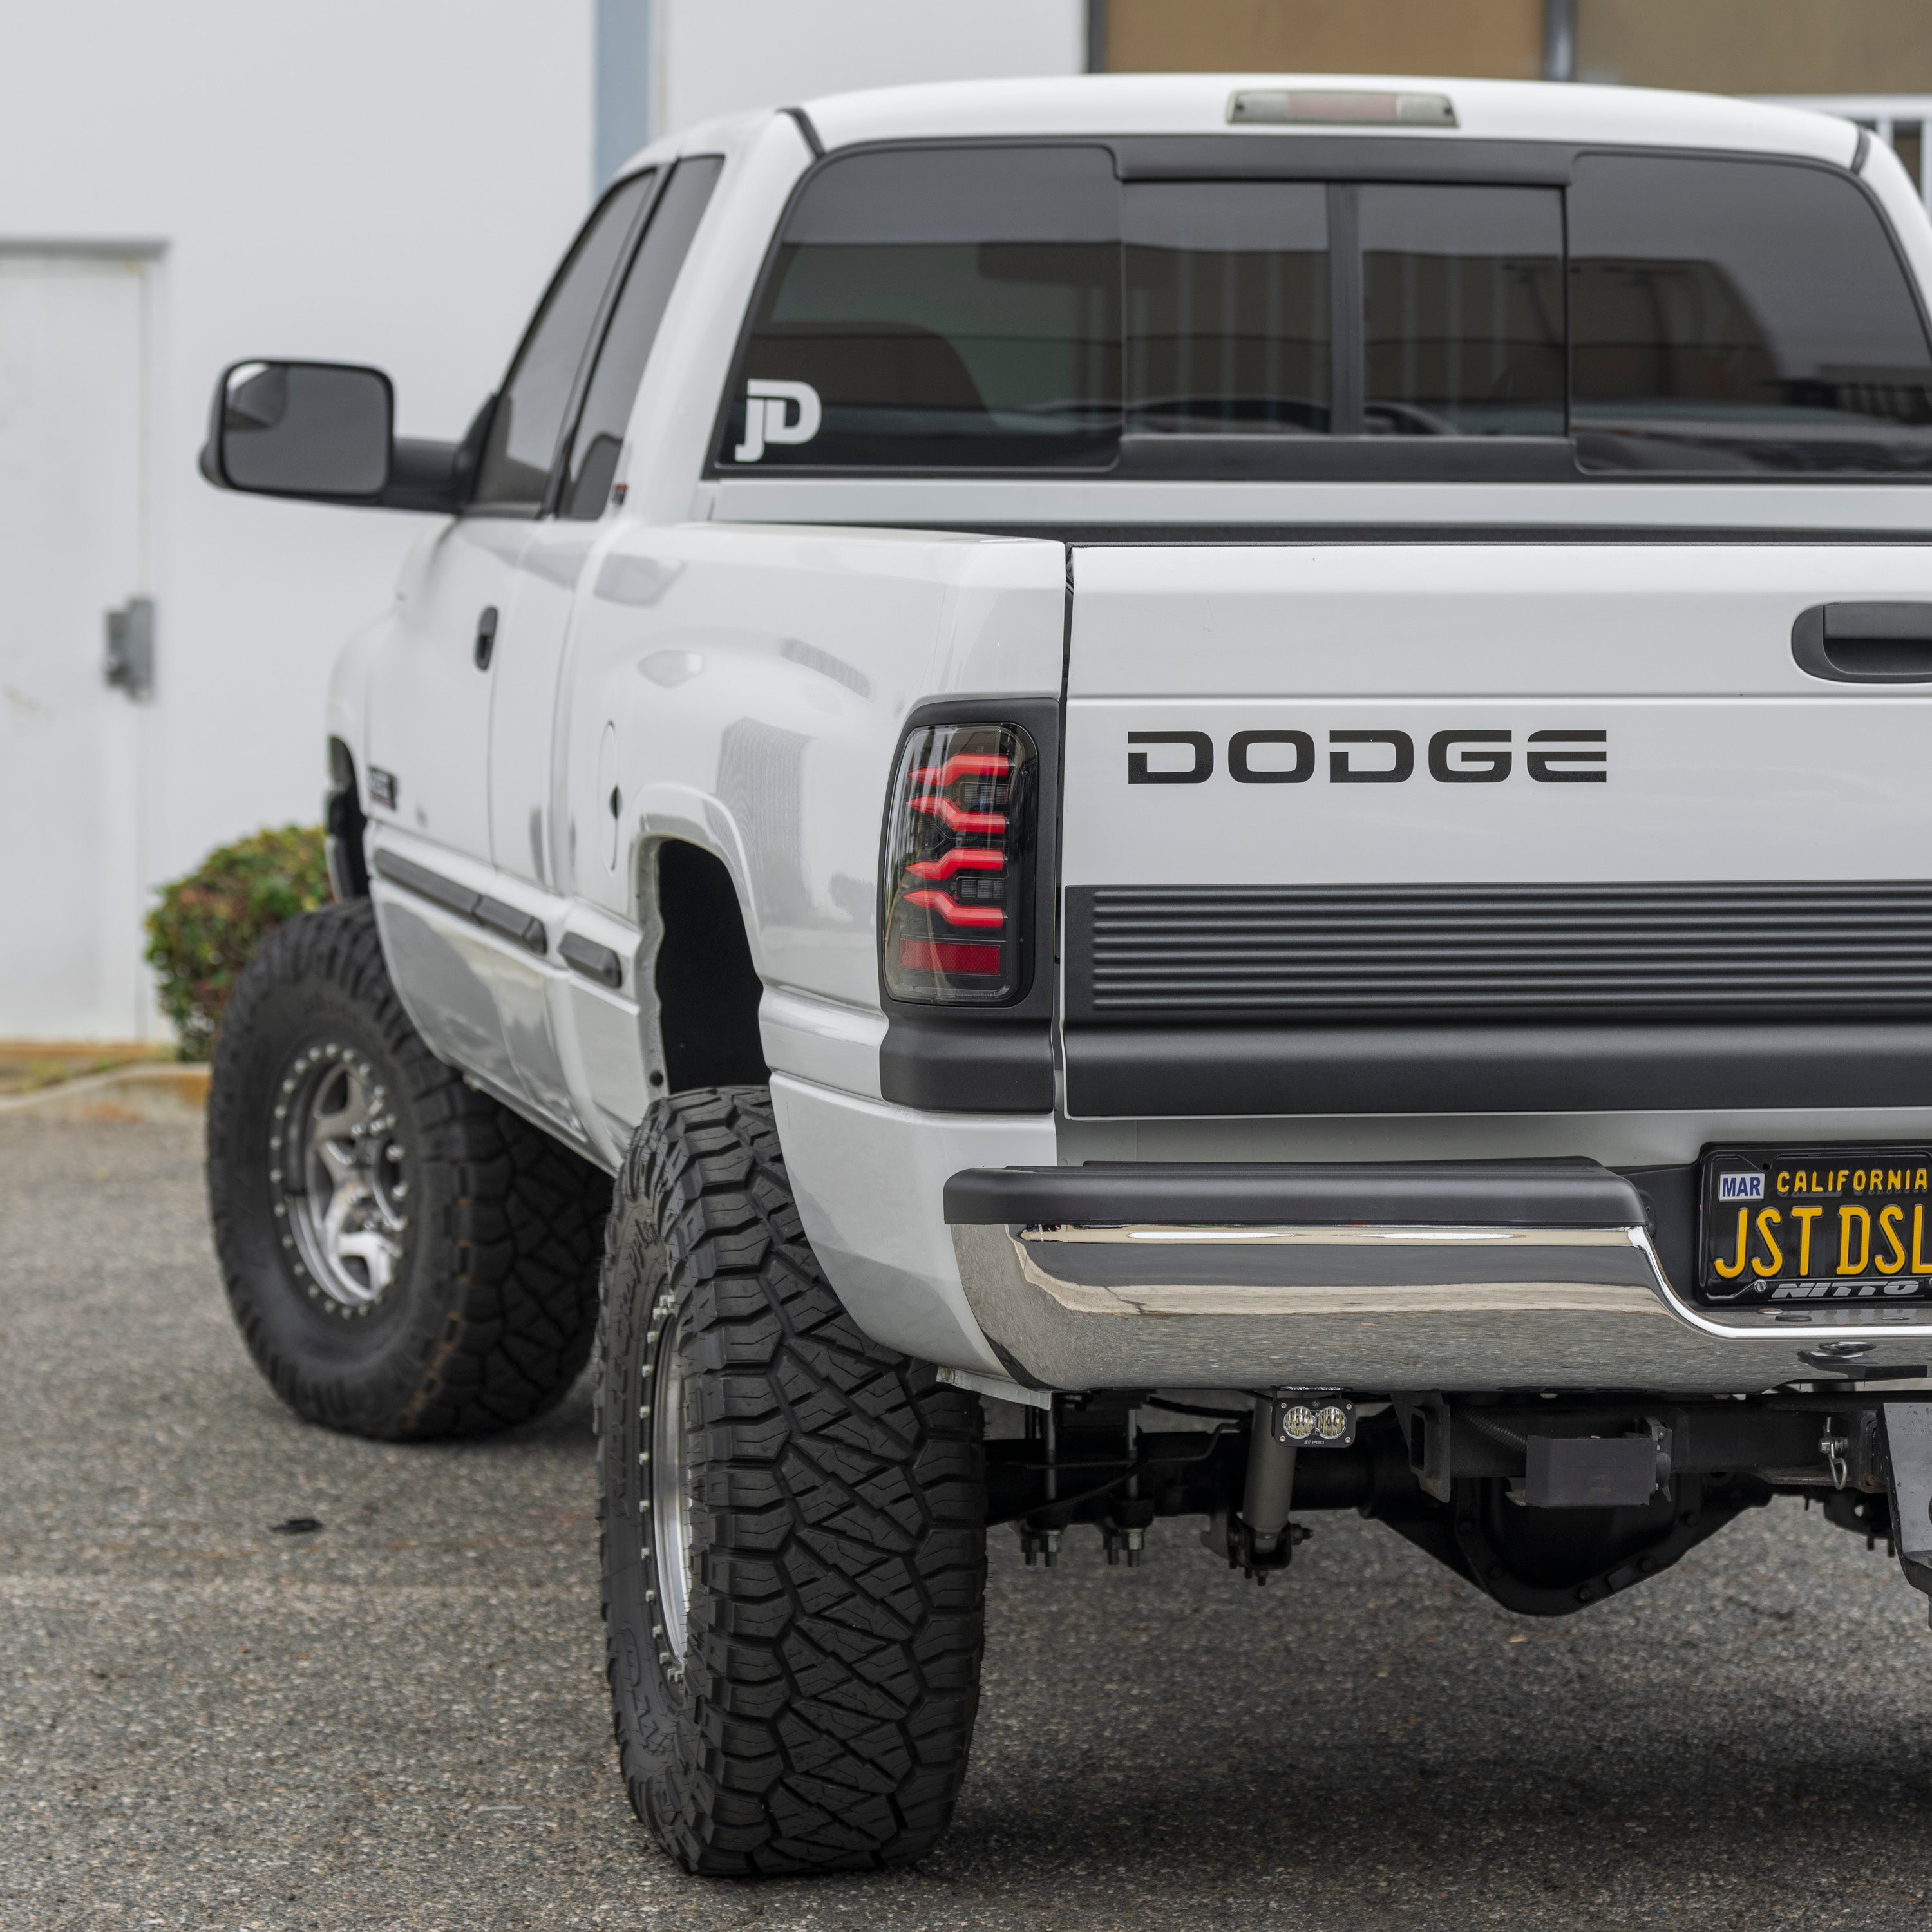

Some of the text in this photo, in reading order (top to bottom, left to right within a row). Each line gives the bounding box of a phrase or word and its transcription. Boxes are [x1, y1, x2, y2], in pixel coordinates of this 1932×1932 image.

[1128, 730, 1607, 784] DODGE
[1722, 1177, 1761, 1197] MAR
[1776, 1168, 1927, 1193] CALIFORNIA
[1714, 1207, 1823, 1278] JST
[1771, 1280, 1920, 1298] NITTO
